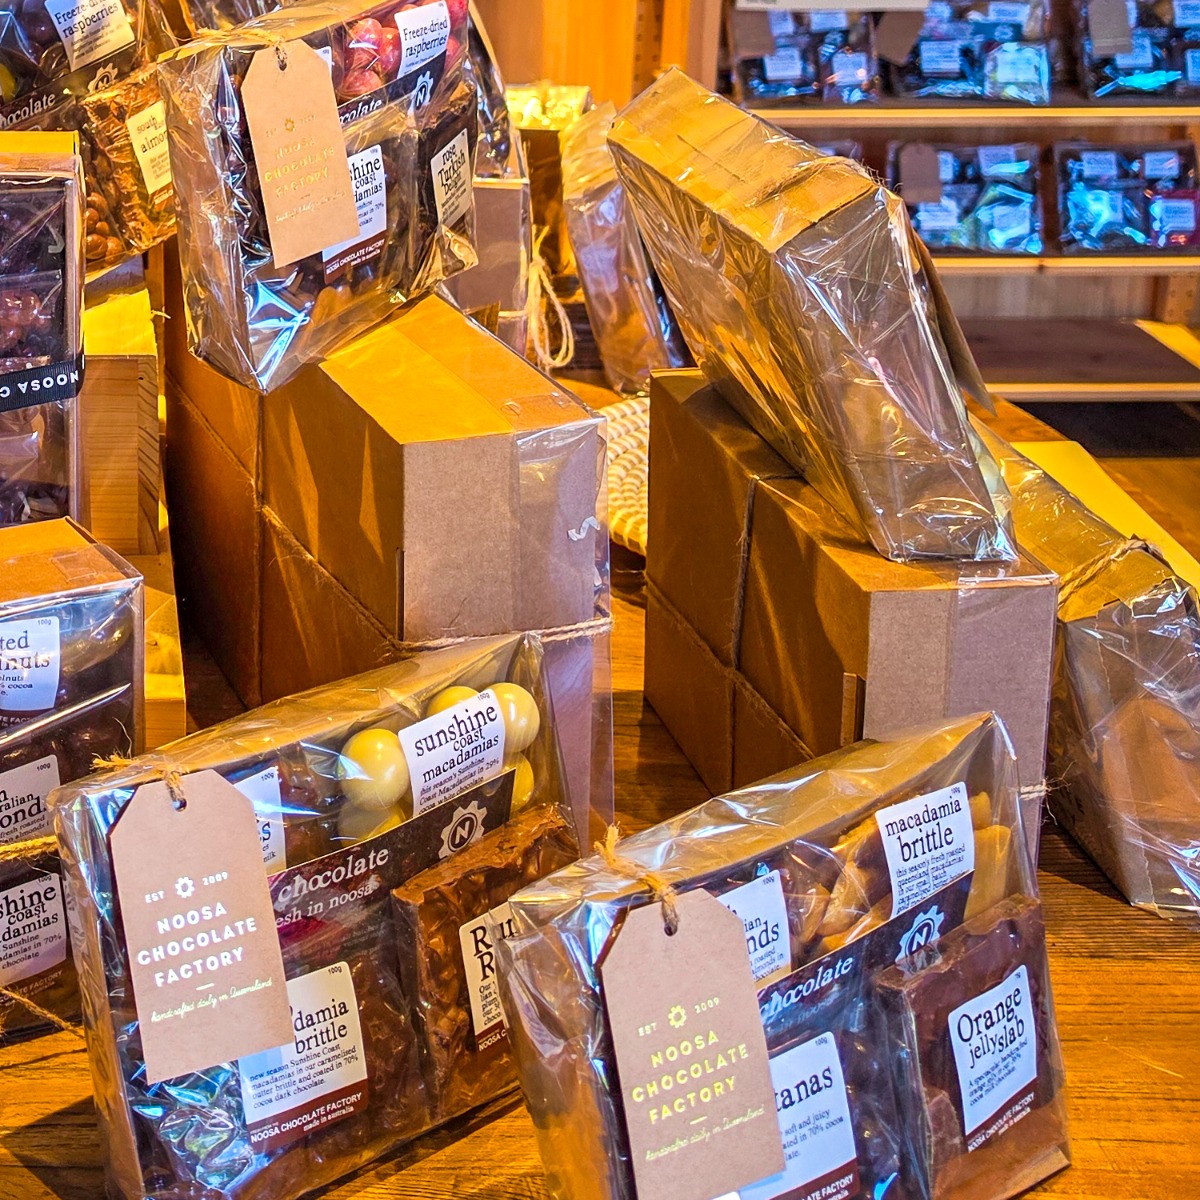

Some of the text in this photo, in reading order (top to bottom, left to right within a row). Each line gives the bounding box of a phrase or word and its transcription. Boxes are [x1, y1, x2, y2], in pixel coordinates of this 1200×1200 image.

[62, 2, 119, 39] raspberries
[403, 18, 448, 43] Freeze-dried
[405, 34, 448, 58] raspberries
[355, 171, 376, 189] coast
[438, 149, 465, 186] Turkish
[17, 370, 79, 394] NOOSA
[414, 706, 498, 757] sunshine
[453, 727, 484, 752] coast
[423, 734, 499, 784] macadamias
[420, 790, 437, 806] Coast
[438, 770, 476, 798] Macadamias
[478, 766, 484, 777] in
[420, 784, 432, 796] this
[885, 796, 961, 836] macadamia
[897, 822, 954, 862] brittle
[145, 872, 228, 903] EST 2009
[278, 848, 389, 902] chocolate
[8, 903, 47, 925] coast
[308, 882, 372, 917] in noosa
[157, 902, 227, 935] NOOSA
[2, 934, 39, 951] Sunshine
[34, 941, 41, 950] in
[137, 918, 257, 965] CHOCOLATE
[2, 952, 39, 970] chocolate
[154, 947, 244, 987] FACTORY
[759, 956, 854, 1021] chocolate
[638, 997, 720, 1037] EST 2009
[957, 986, 1023, 1043] Orange
[295, 1022, 348, 1054] brittle
[651, 1030, 719, 1069] NOOSA
[969, 1015, 1025, 1069] jellyslab
[250, 1043, 340, 1082] new season Sunshine Coast
[275, 1055, 358, 1091] brittle and coated in 70%
[305, 1063, 316, 1072] our
[318, 1046, 356, 1067] caramelised
[631, 1044, 748, 1103] CHOCOLATE
[251, 1092, 362, 1143] NOOSA CHOCOLATE FACTORY
[254, 1098, 273, 1109] cocoa
[275, 1091, 291, 1102] dark
[648, 1076, 736, 1125] FACTORY
[303, 1118, 320, 1131] made
[321, 1116, 327, 1124] in
[822, 1173, 854, 1199] FACTORY
